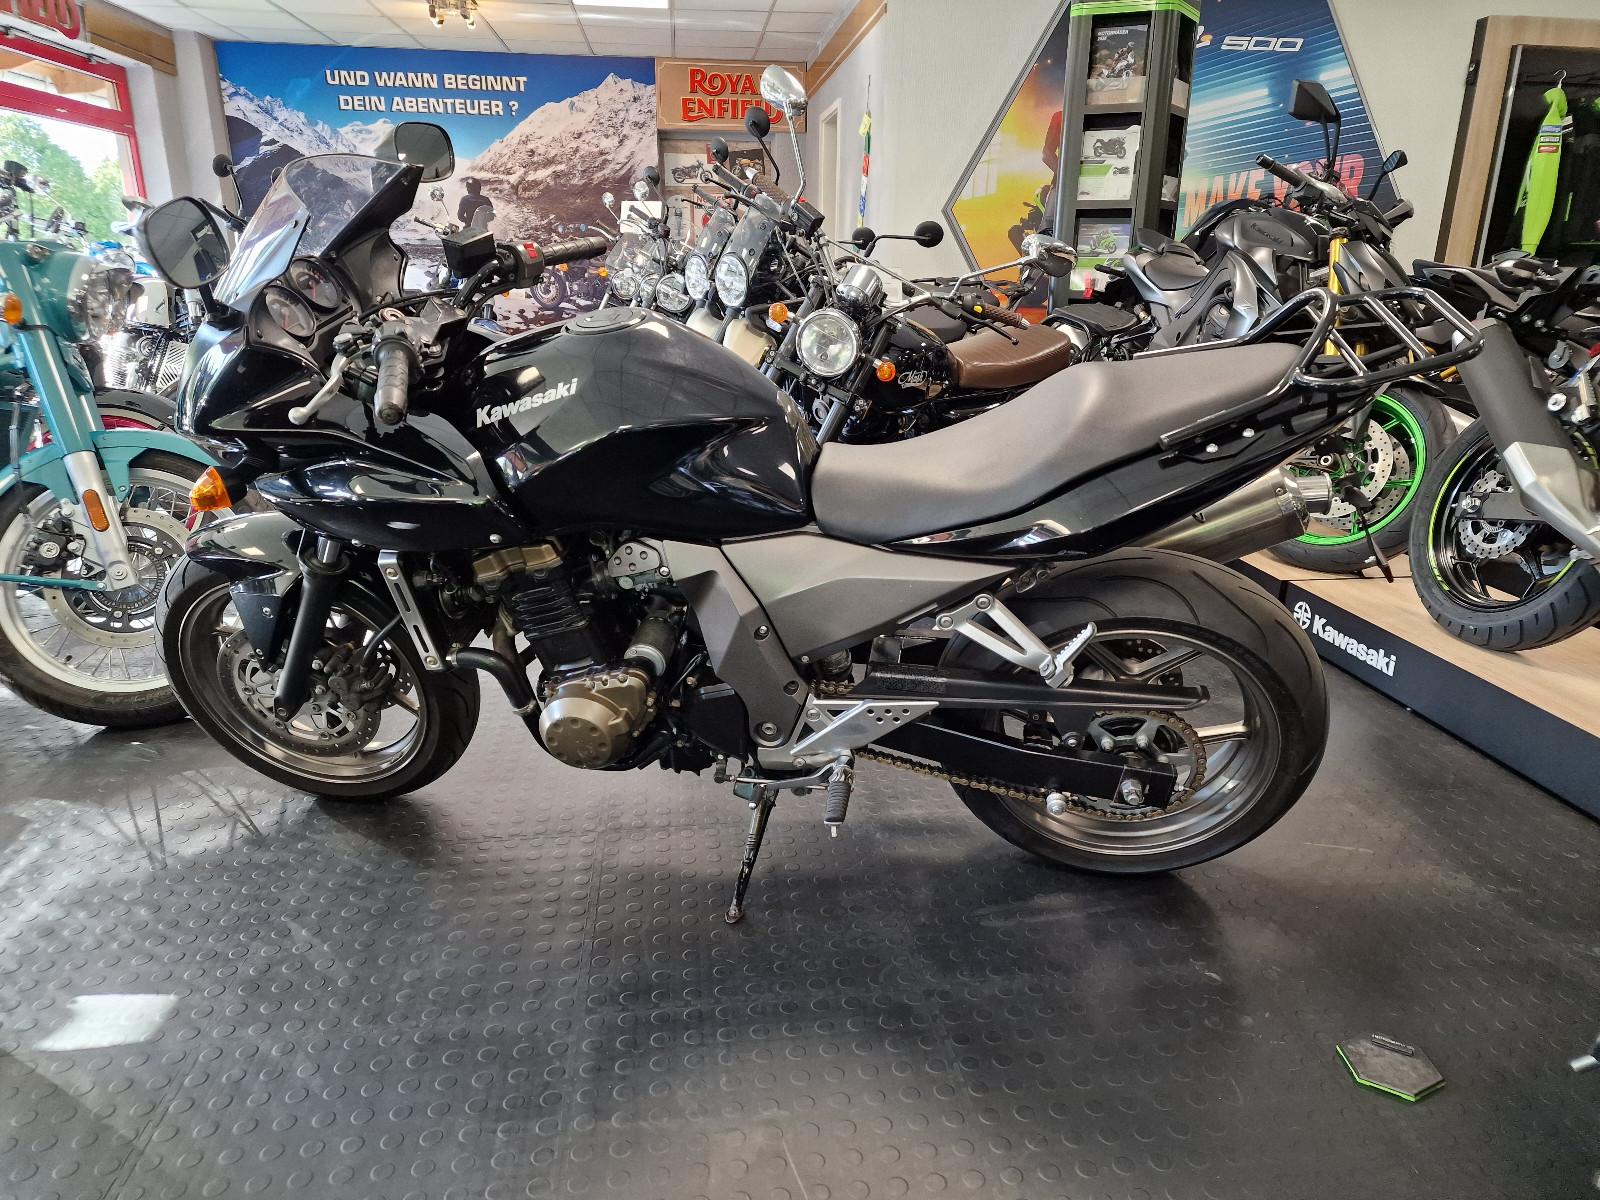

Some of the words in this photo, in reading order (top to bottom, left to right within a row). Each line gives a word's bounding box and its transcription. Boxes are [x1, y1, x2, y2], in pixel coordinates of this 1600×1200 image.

[1221, 35, 1305, 52] 500
[325, 69, 370, 86] UND
[374, 71, 438, 89] WANN
[443, 74, 528, 92] BEGINNT
[688, 67, 762, 97] ROYA
[338, 95, 386, 112] DEIN
[391, 97, 504, 116] ABENTEUER
[509, 100, 519, 116] ?
[476, 377, 579, 429] Kawasaki
[1312, 614, 1398, 677] Kawasaki
